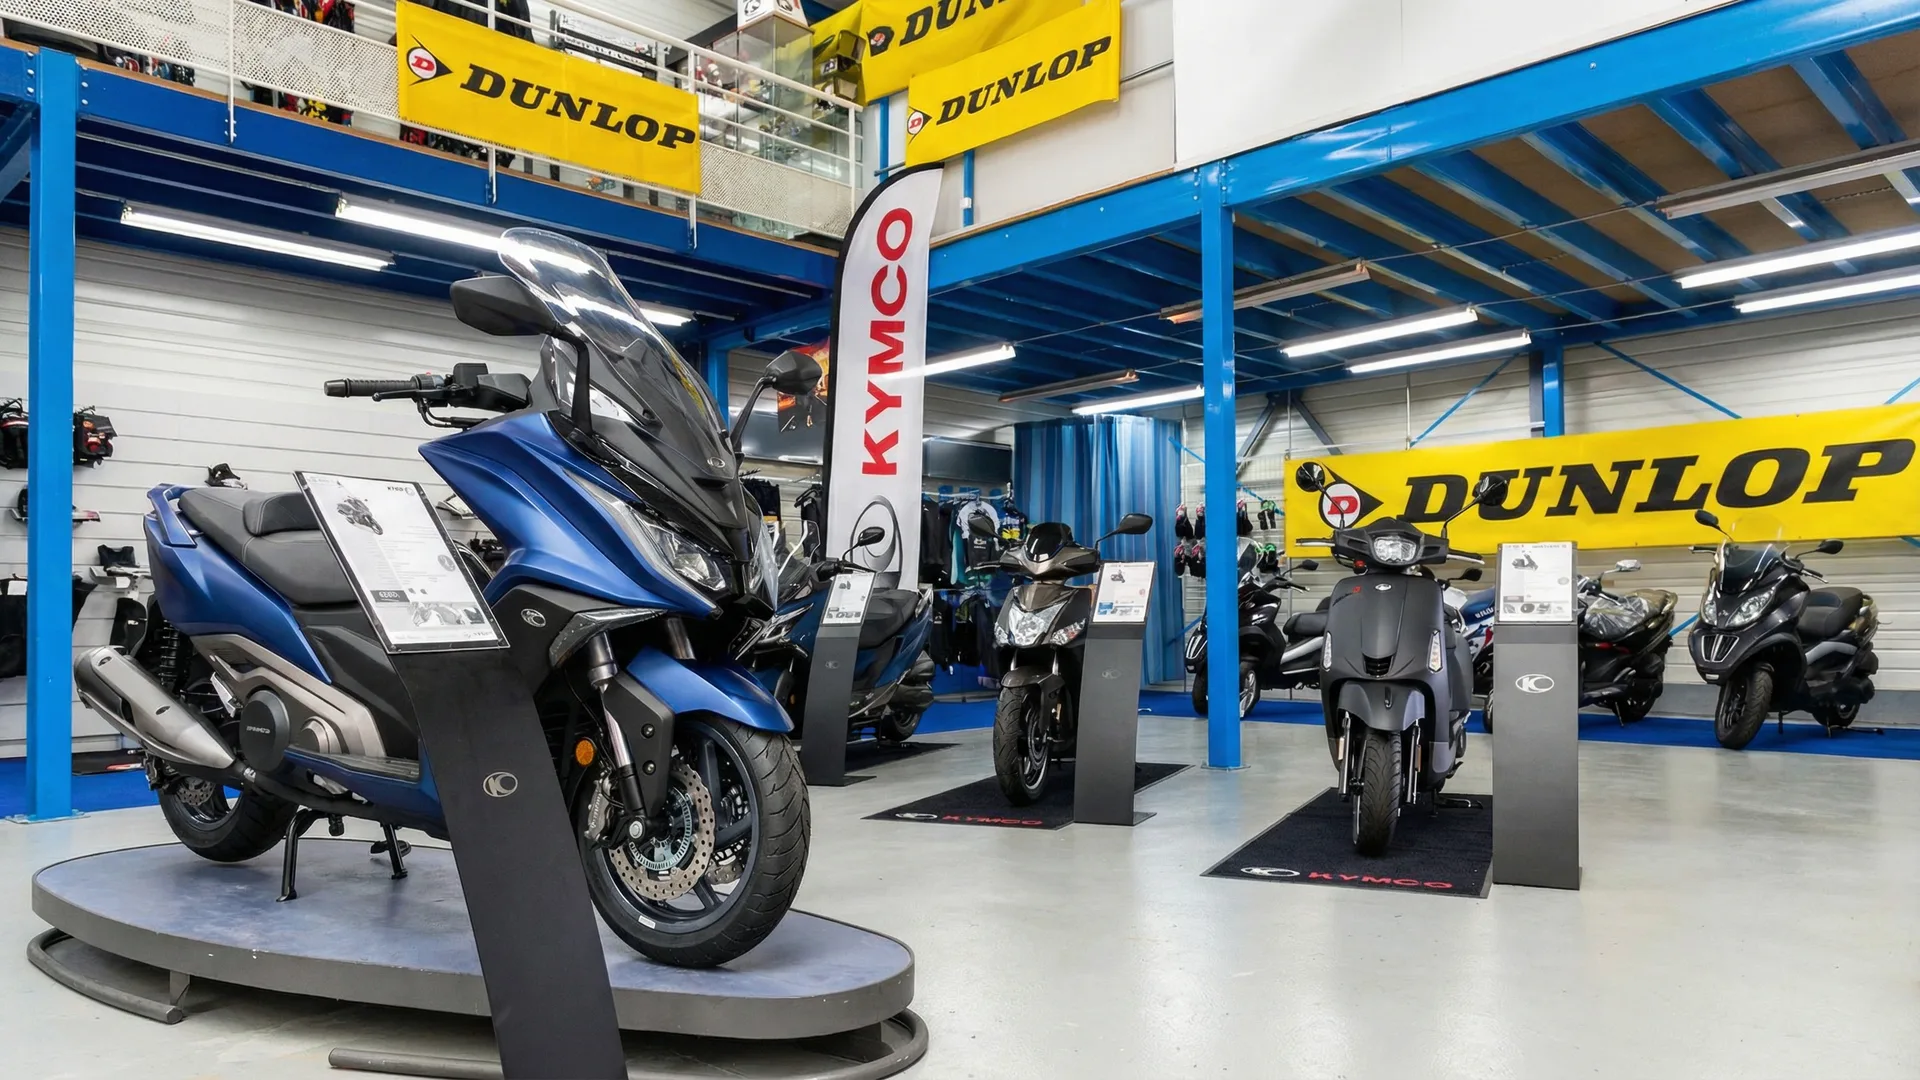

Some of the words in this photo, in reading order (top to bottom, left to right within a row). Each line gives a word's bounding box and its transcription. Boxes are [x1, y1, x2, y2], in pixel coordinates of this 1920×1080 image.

[411, 55, 435, 72] D
[936, 36, 1112, 125] DUNLOP
[460, 63, 696, 149] DUNLOP
[909, 116, 922, 129] D
[862, 207, 913, 476] KYMCO
[1396, 438, 1916, 522] DUNLOP
[1327, 495, 1359, 515] D
[942, 814, 1043, 825] KYMCO
[1308, 871, 1453, 889] KYMCO
